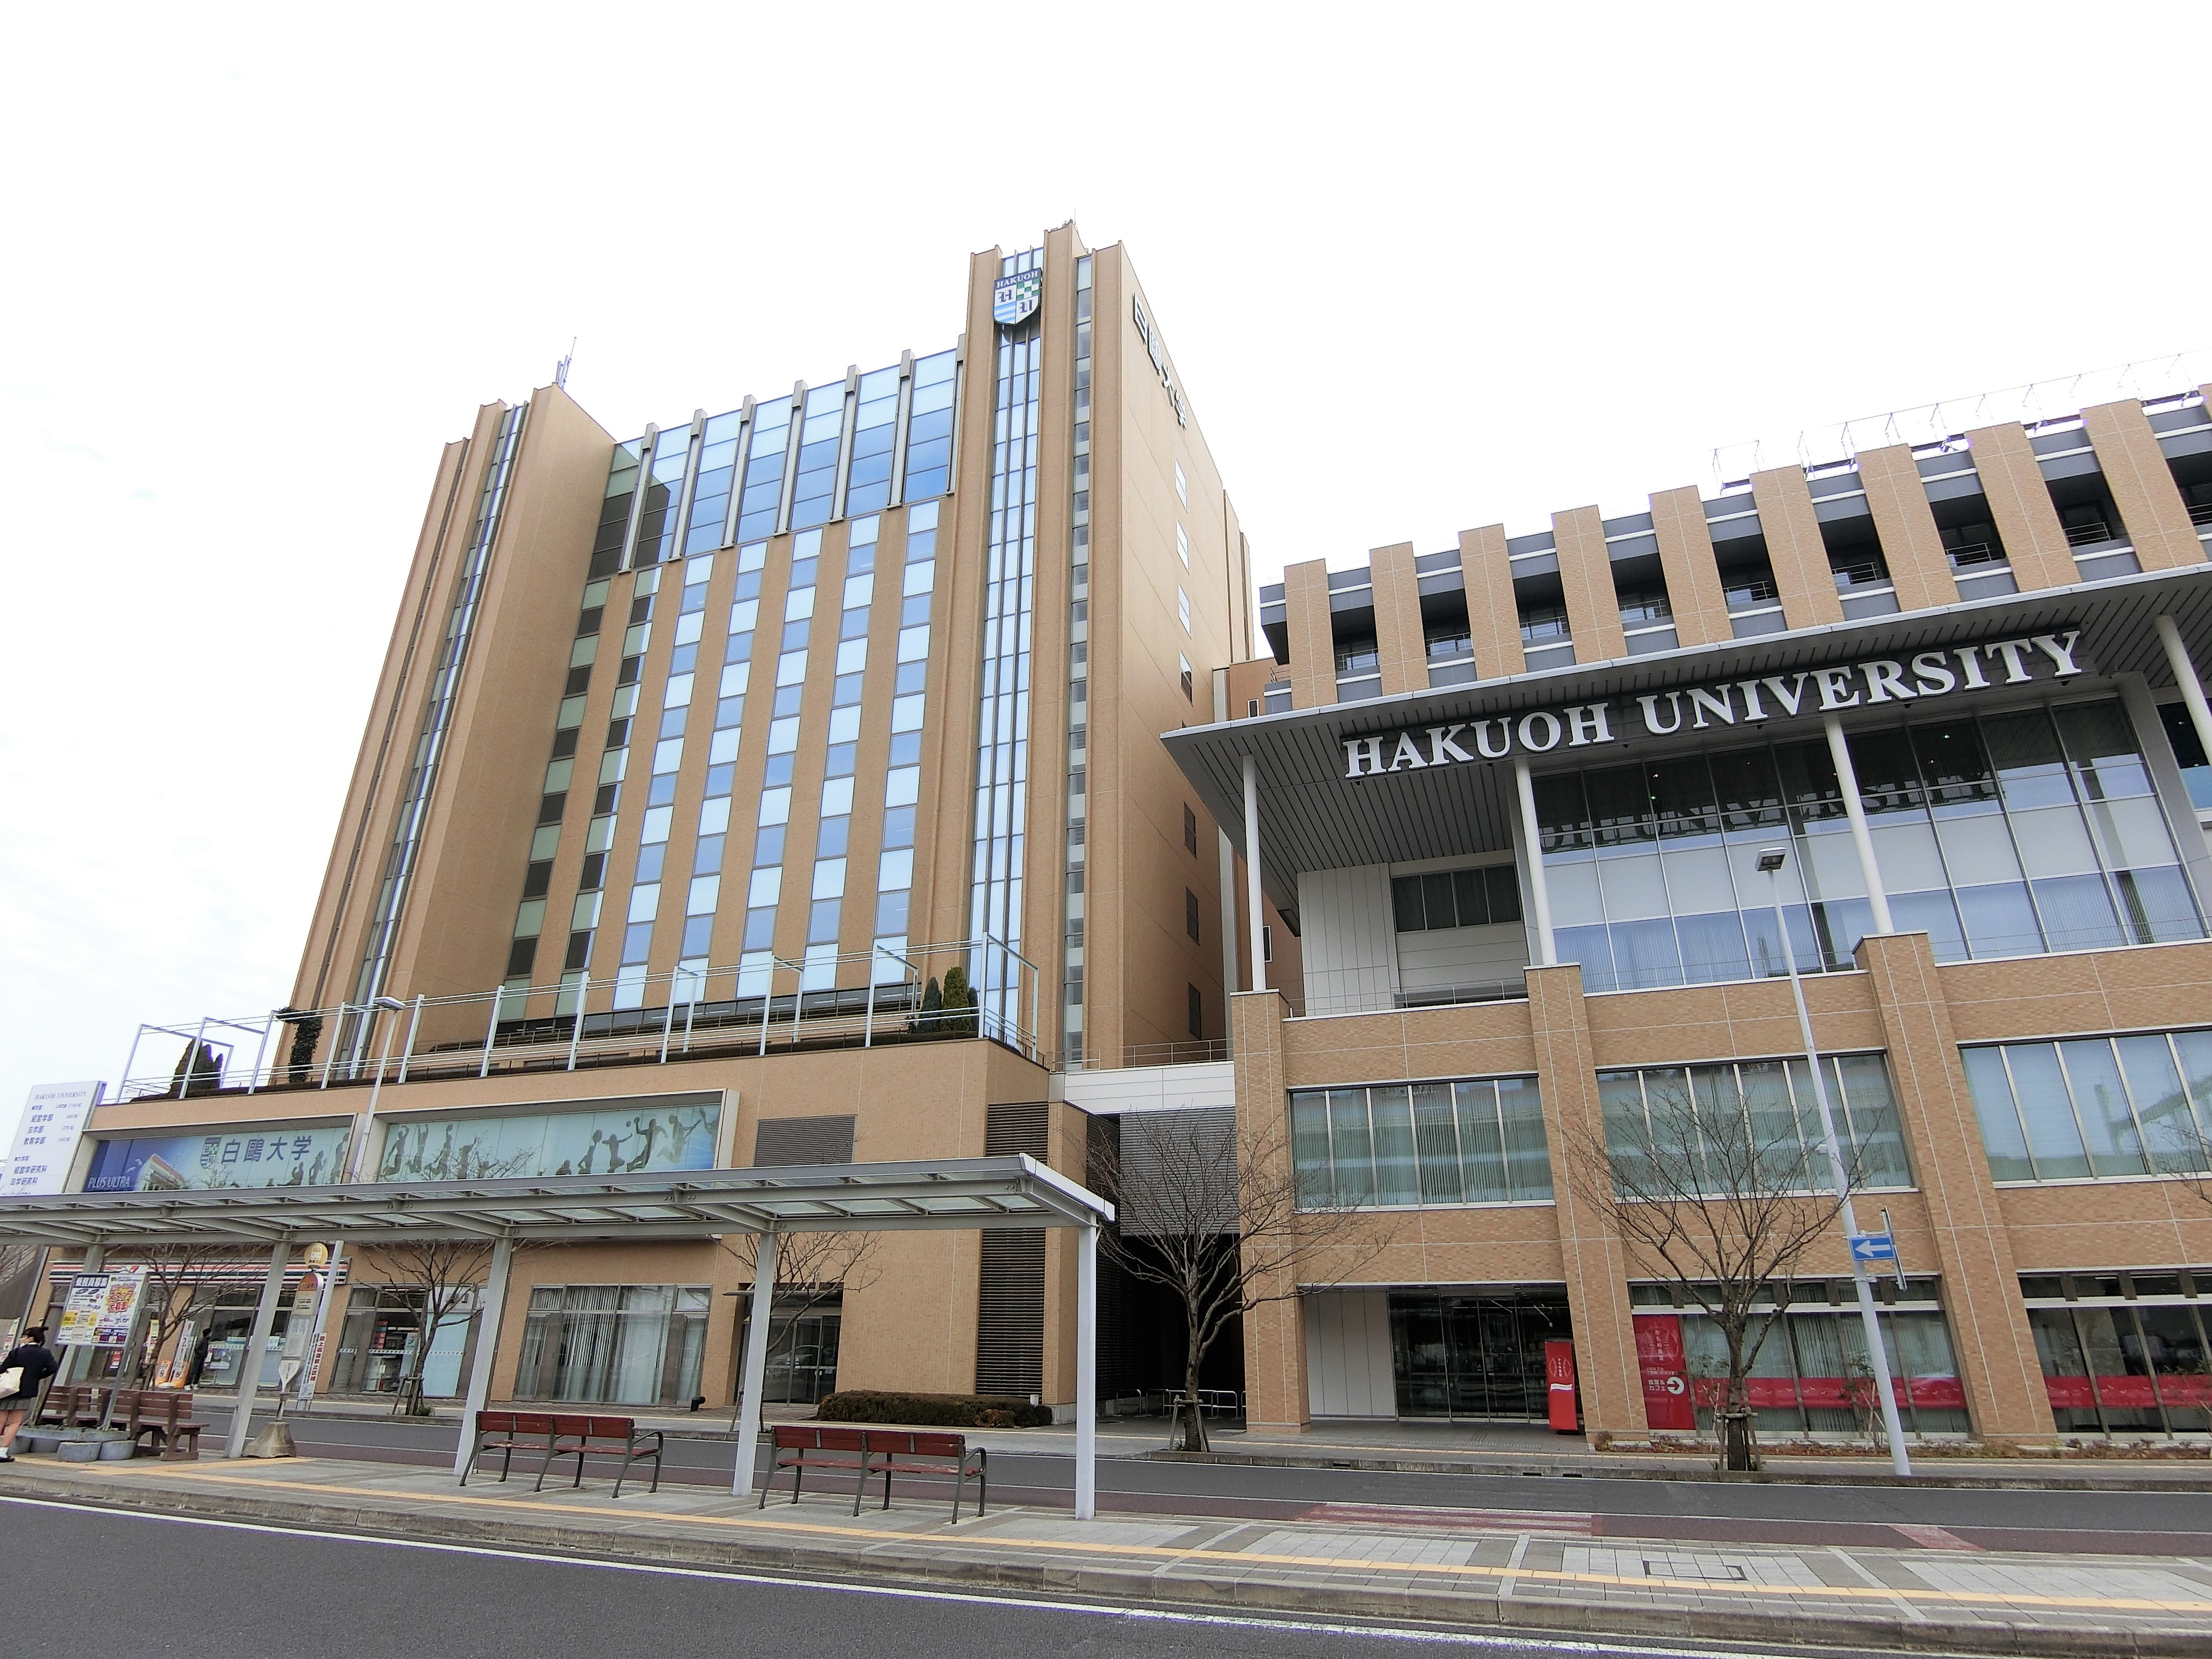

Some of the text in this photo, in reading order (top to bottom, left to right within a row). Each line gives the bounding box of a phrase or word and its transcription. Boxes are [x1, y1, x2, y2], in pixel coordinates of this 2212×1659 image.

[997, 270, 1038, 288] HAKUOH
[1343, 630, 2083, 778] HAKUOH UNIVERSITY
[88, 1176, 130, 1188] PLUS ULTRA
